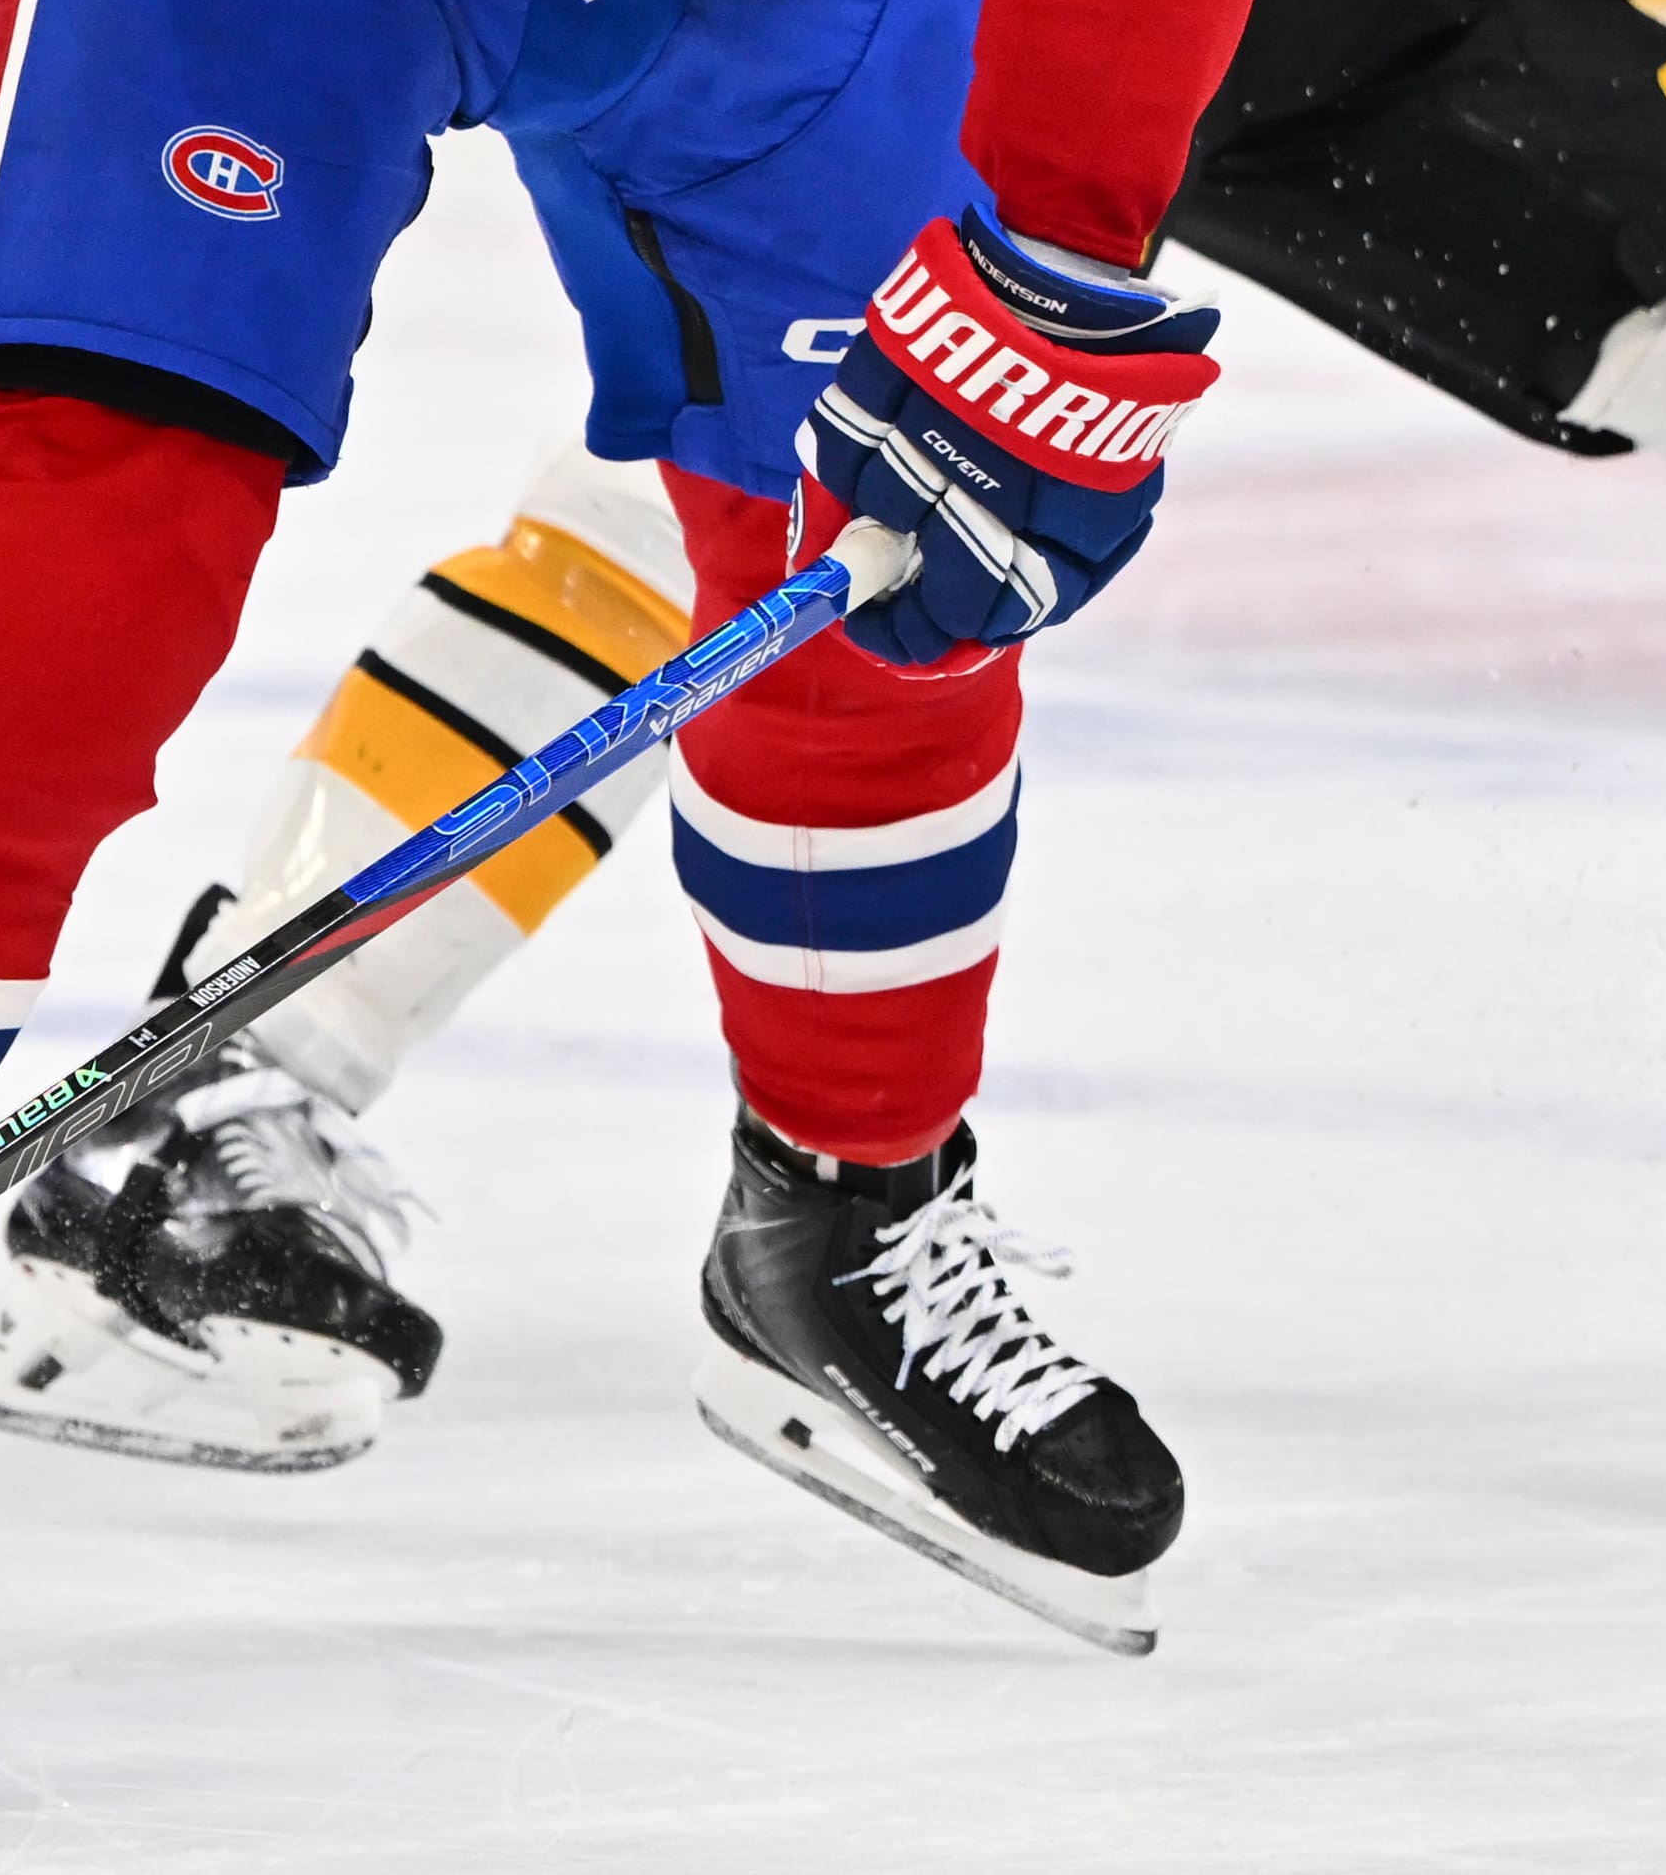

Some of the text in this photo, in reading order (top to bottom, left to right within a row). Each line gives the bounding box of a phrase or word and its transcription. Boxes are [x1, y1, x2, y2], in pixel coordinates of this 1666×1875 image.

[967, 236, 1068, 315] ANDERSON
[871, 246, 1202, 464] WARRIOR
[921, 428, 1001, 492] COVERT
[669, 634, 786, 727] BAUER
[188, 955, 262, 1009] ANDERSON
[823, 1364, 938, 1473] BAUER
